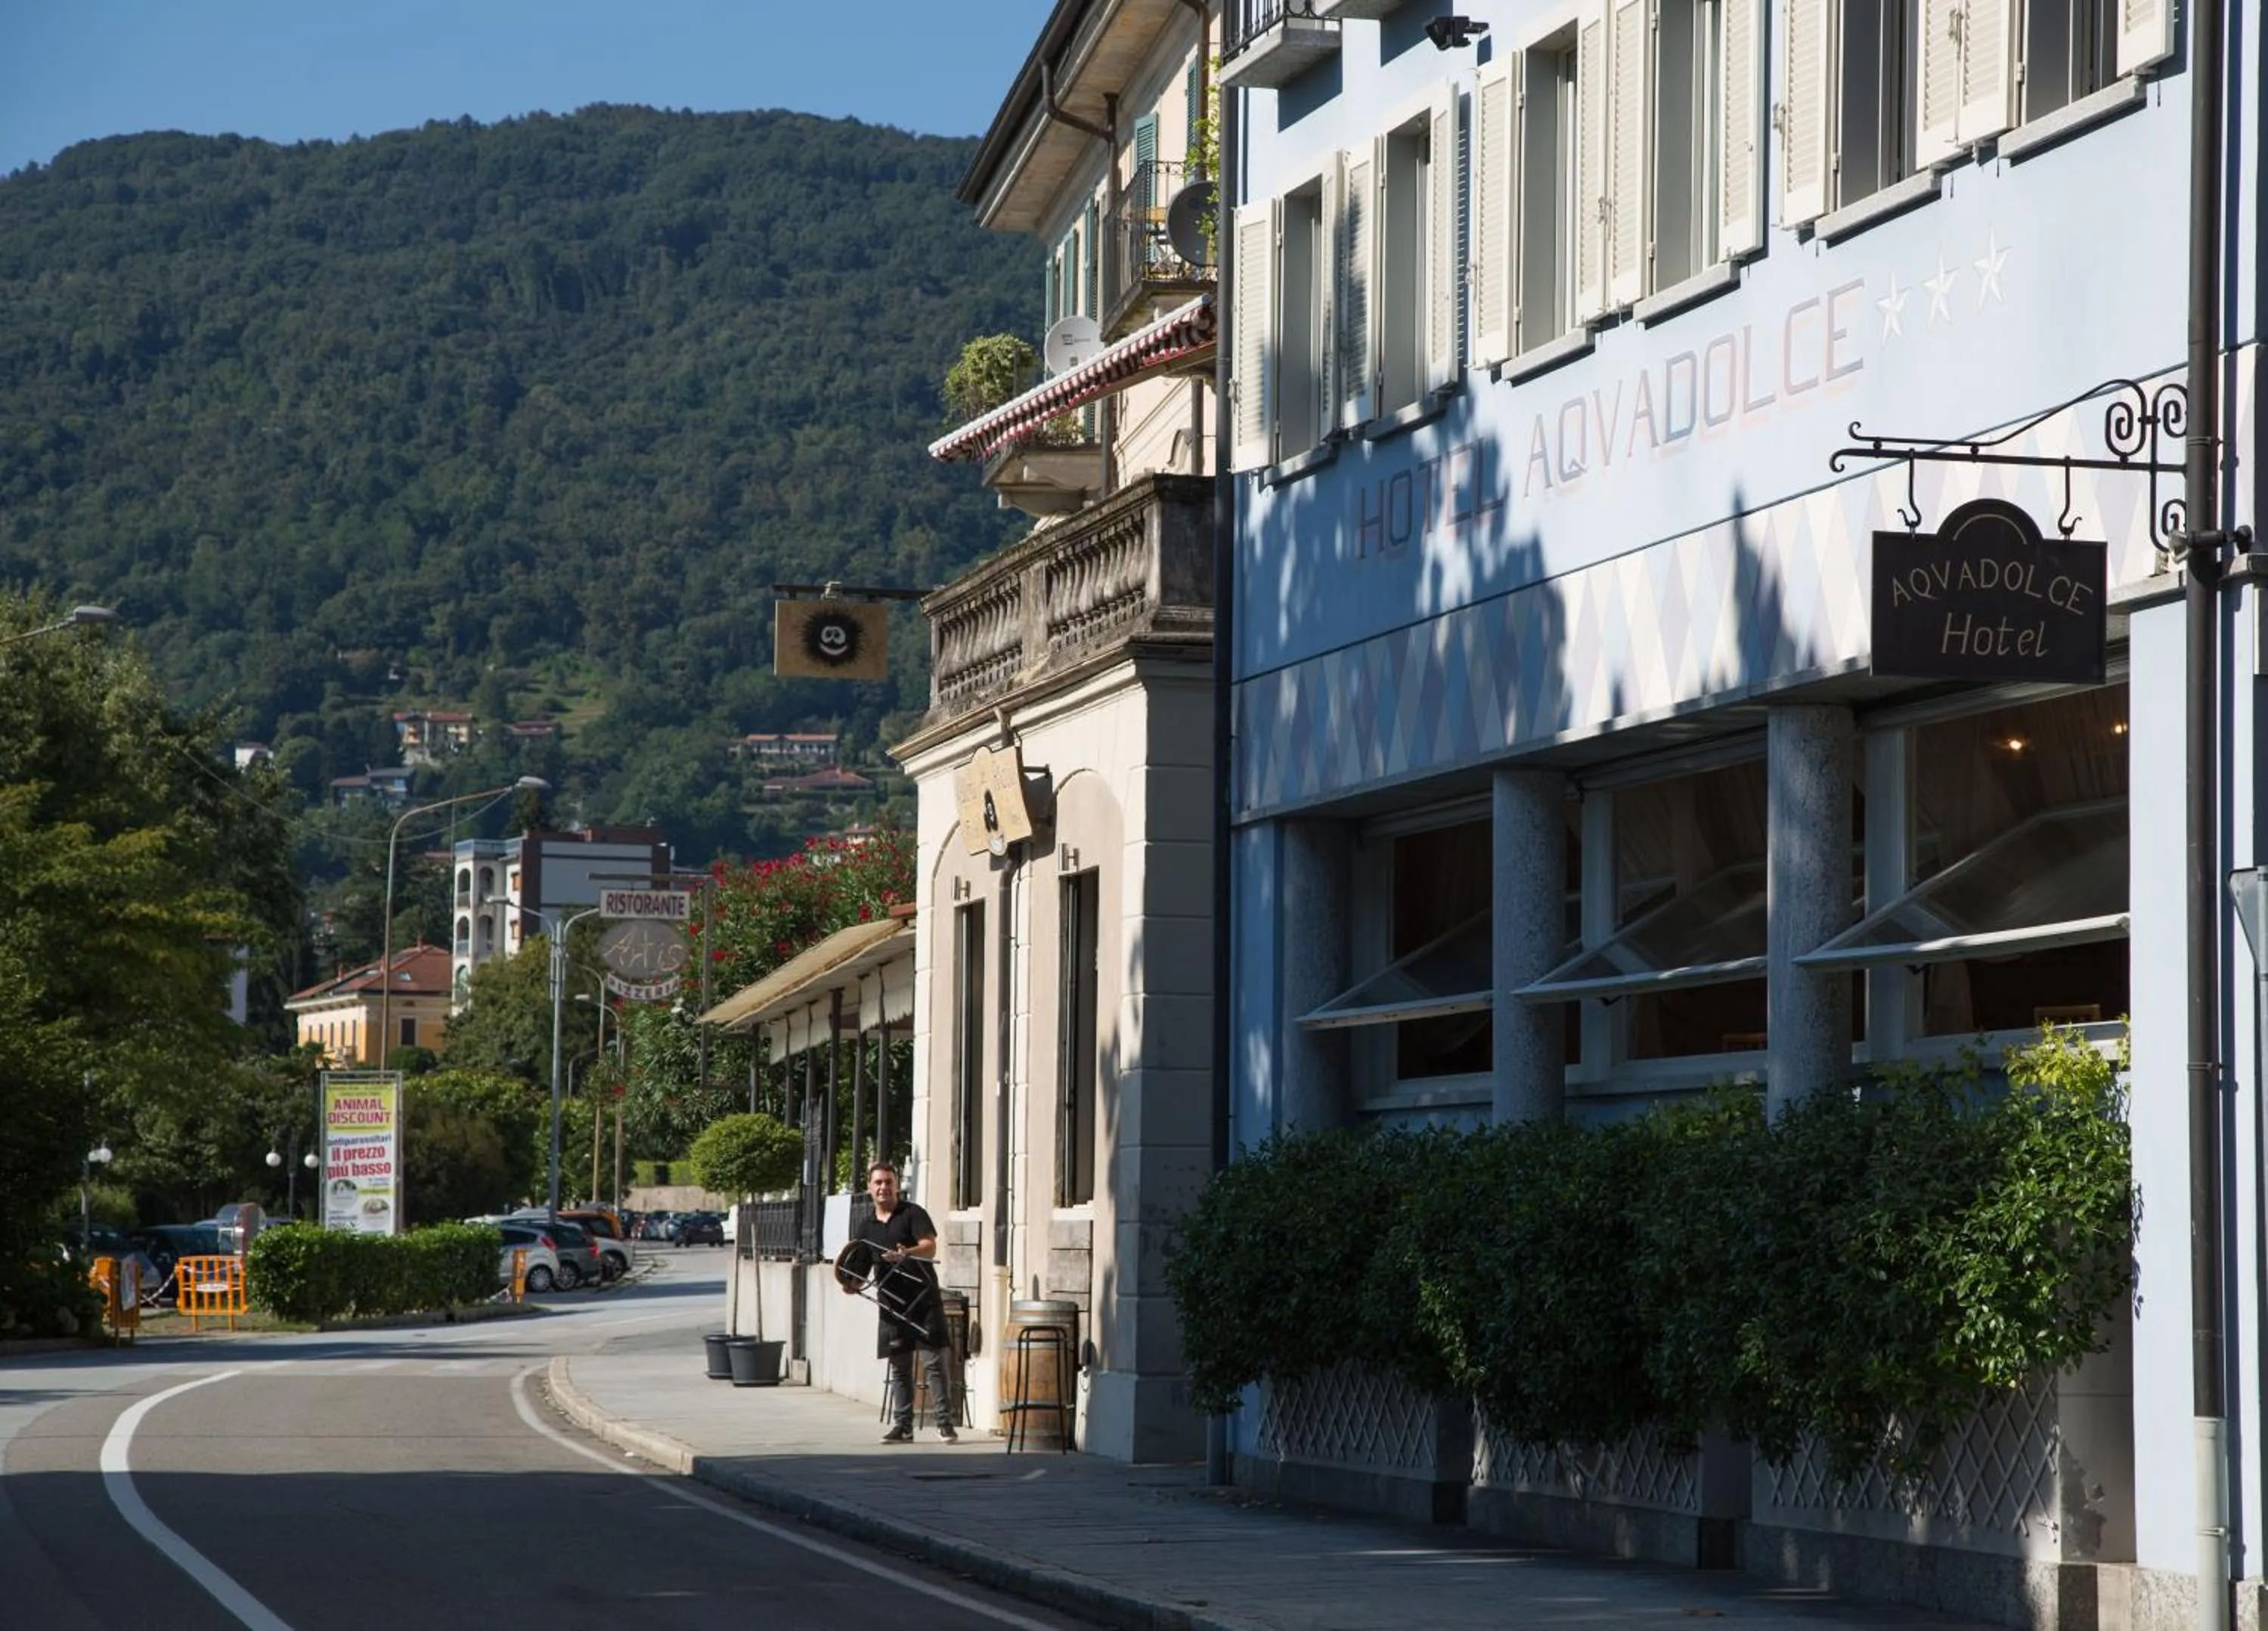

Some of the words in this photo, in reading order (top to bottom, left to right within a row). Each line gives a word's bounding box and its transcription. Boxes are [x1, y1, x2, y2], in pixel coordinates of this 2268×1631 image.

[1359, 436, 1508, 559] HOTEL
[1523, 277, 1866, 498] AQVADOLCE
[1892, 559, 2093, 616] AQVADOLCE
[1941, 612, 2051, 658] Hotel
[606, 893, 686, 916] RISTORANTE
[608, 976, 680, 999] PIZZERIA
[333, 1098, 387, 1110] ANIMAL
[327, 1111, 392, 1124] DISCOUNT
[332, 1147, 341, 1162] il
[343, 1146, 386, 1162] prezzo
[352, 1162, 392, 1177] basso
